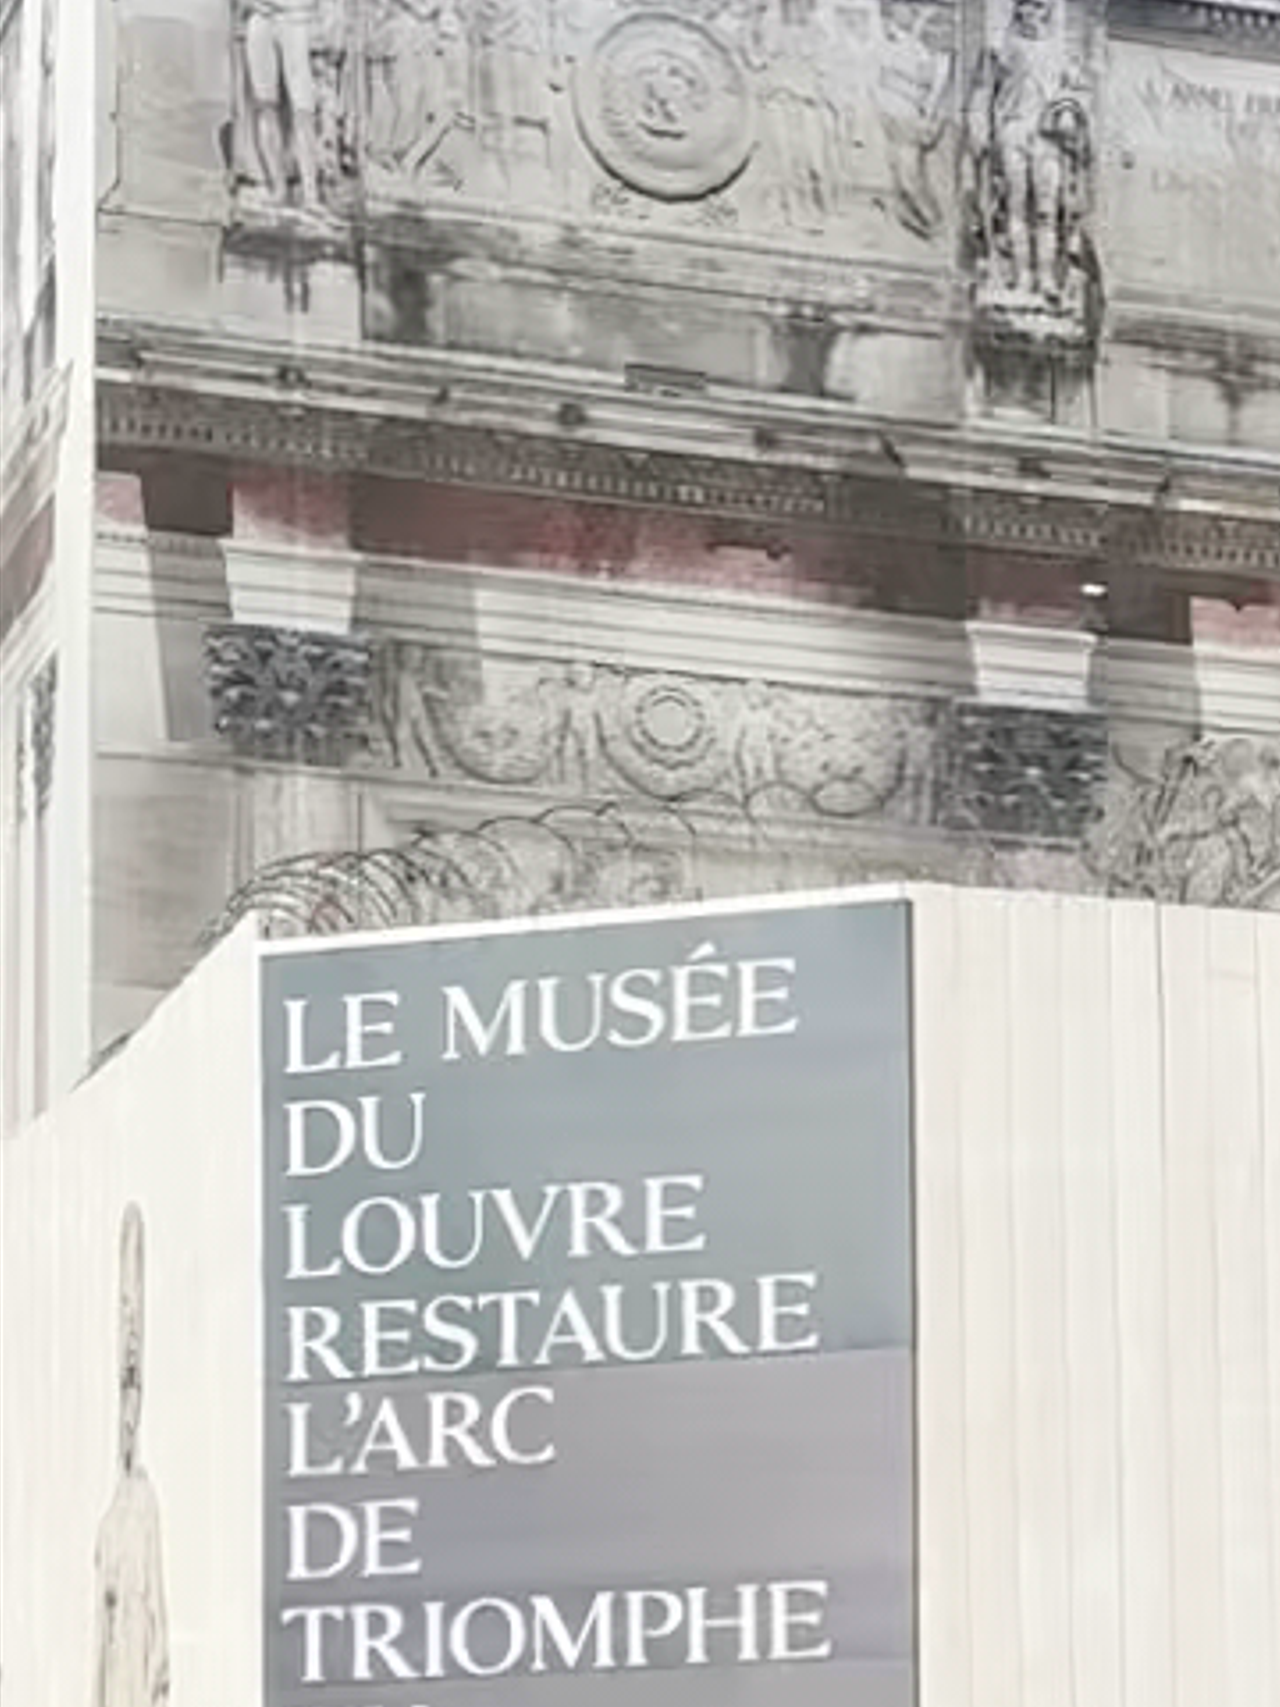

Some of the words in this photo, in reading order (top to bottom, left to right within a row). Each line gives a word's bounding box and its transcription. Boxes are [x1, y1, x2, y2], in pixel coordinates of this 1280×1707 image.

[283, 989, 402, 1074] LE
[440, 943, 799, 1061] MUSÉE
[283, 1092, 427, 1176] DU
[283, 1174, 707, 1280] LOUVRE
[286, 1270, 820, 1382] RESTAURE
[287, 1497, 422, 1580] DE
[281, 1579, 832, 1682] TRIOMPHE
